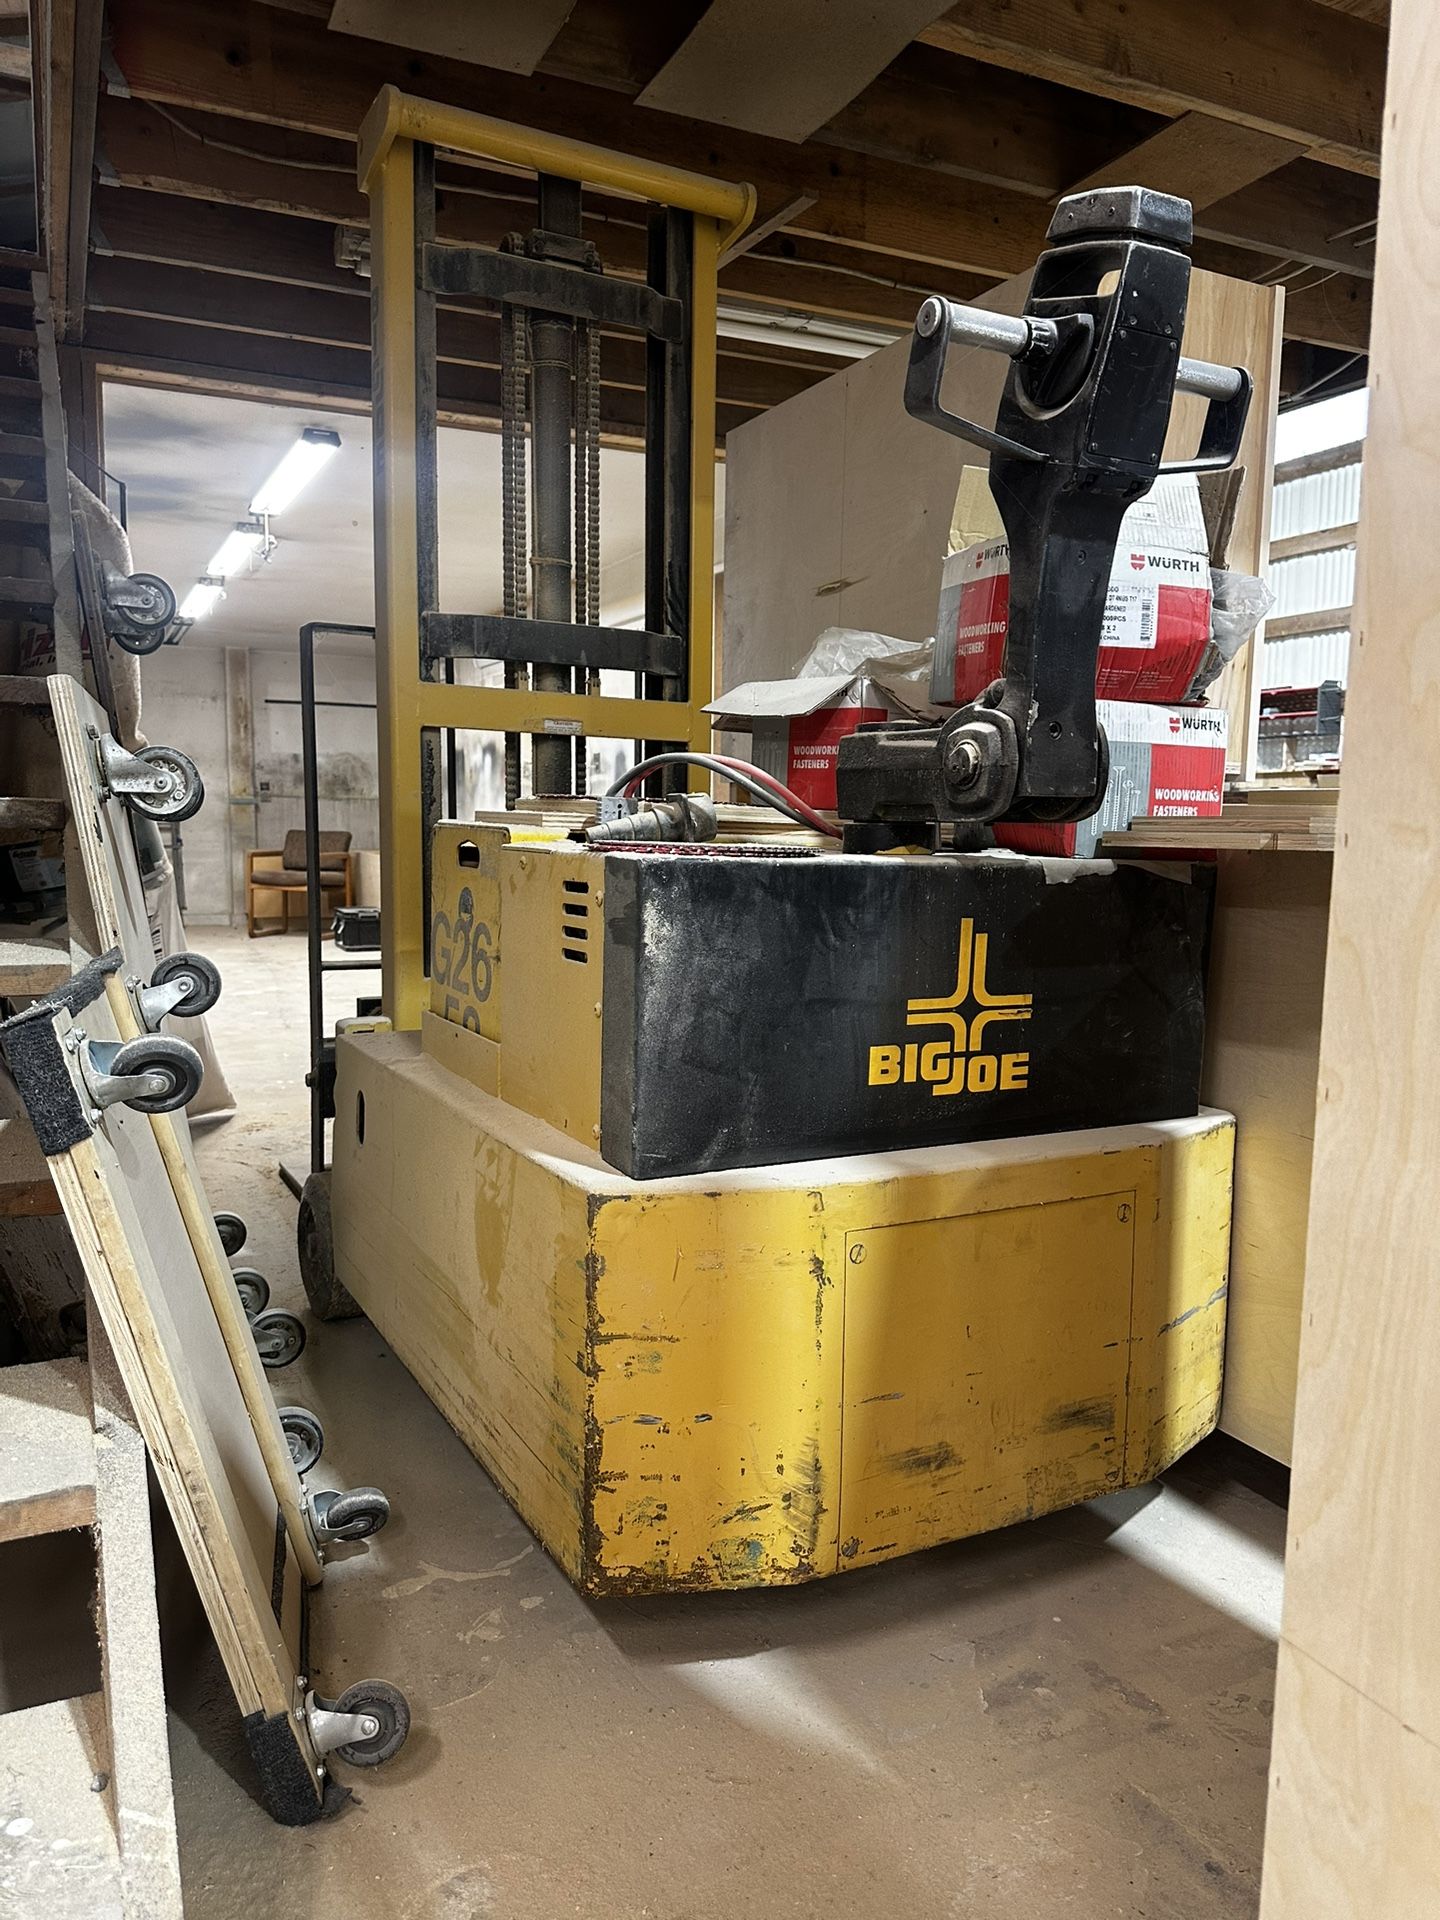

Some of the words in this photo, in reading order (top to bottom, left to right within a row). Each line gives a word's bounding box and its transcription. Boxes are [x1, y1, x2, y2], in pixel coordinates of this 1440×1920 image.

[1147, 555, 1200, 573] WÜRTH
[1104, 604, 1126, 612] ARDENED
[959, 621, 1006, 638] WOODWORKING
[957, 641, 985, 655] FASTENERS
[1182, 717, 1221, 732] WÜRTH
[793, 745, 839, 755] WOODWORKI
[792, 759, 829, 769] FASTENERS
[1154, 788, 1220, 803] WOODWORKING
[1152, 804, 1199, 817] FASTENERS
[431, 911, 492, 1003] G26
